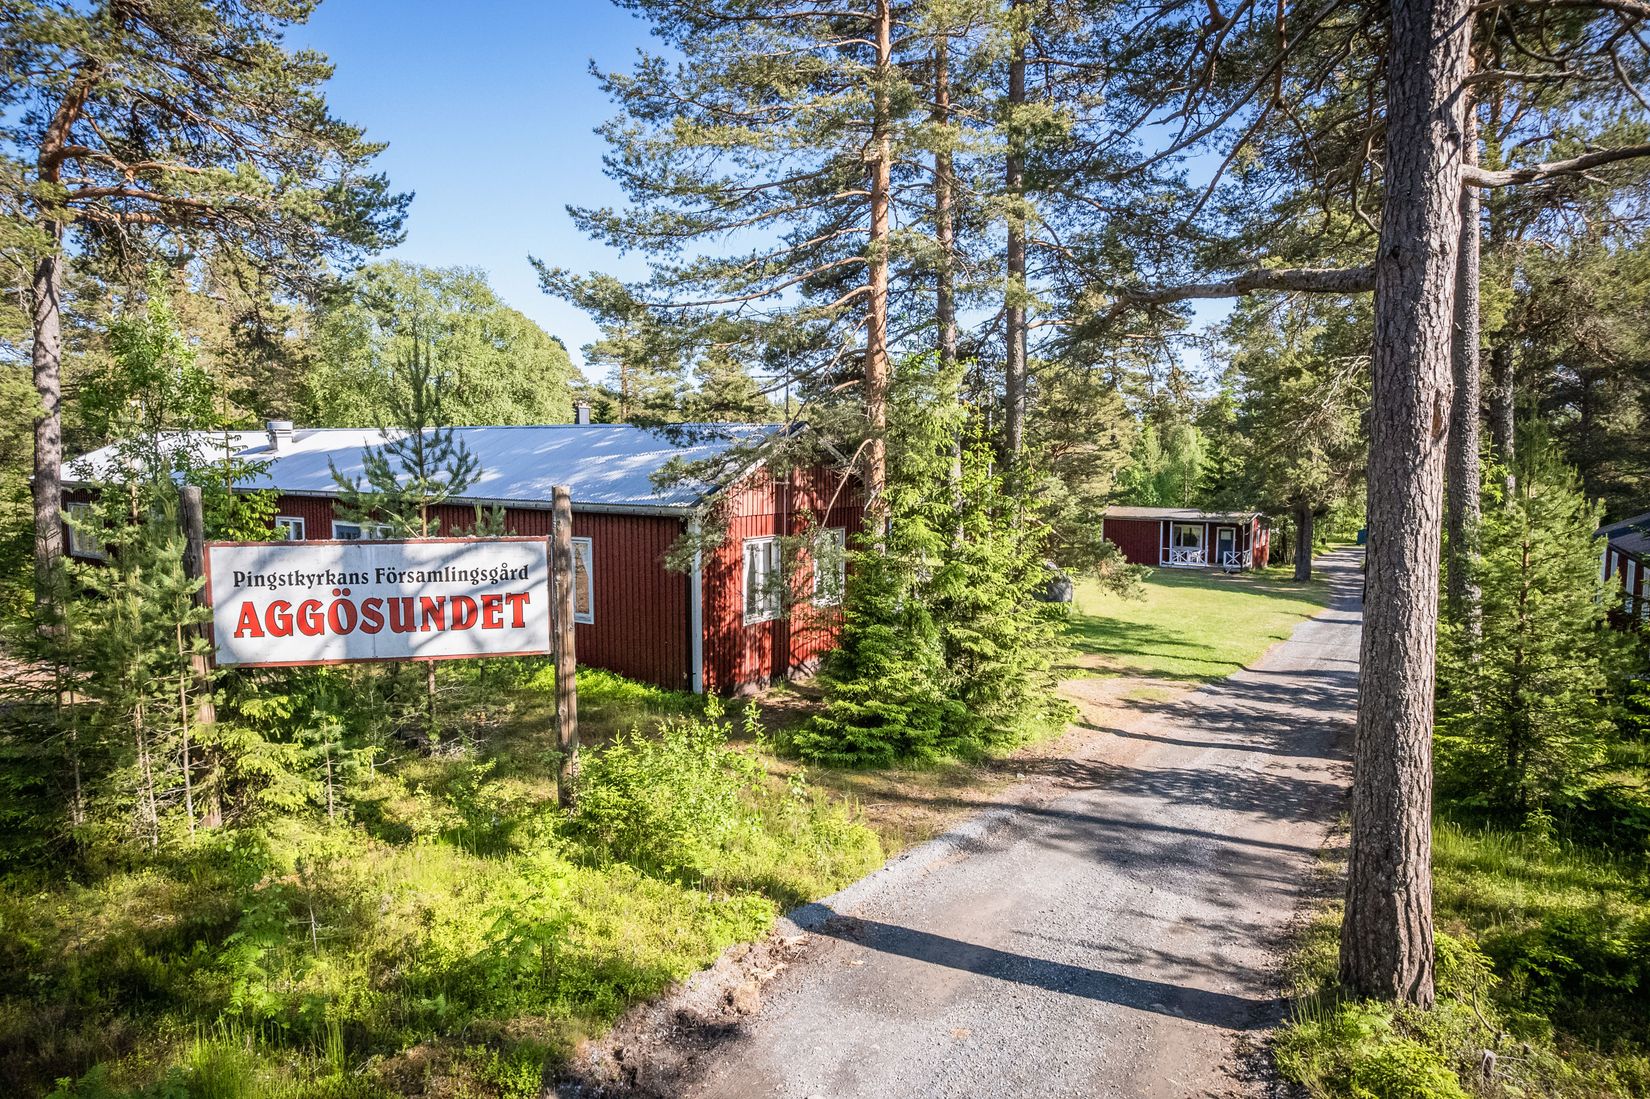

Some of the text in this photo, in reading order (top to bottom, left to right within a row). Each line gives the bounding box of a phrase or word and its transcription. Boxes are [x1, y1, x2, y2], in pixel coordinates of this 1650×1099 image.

[233, 562, 529, 591] Pingstkyrkans Församlingsgård
[233, 588, 530, 638] AGGÖSUNDET
